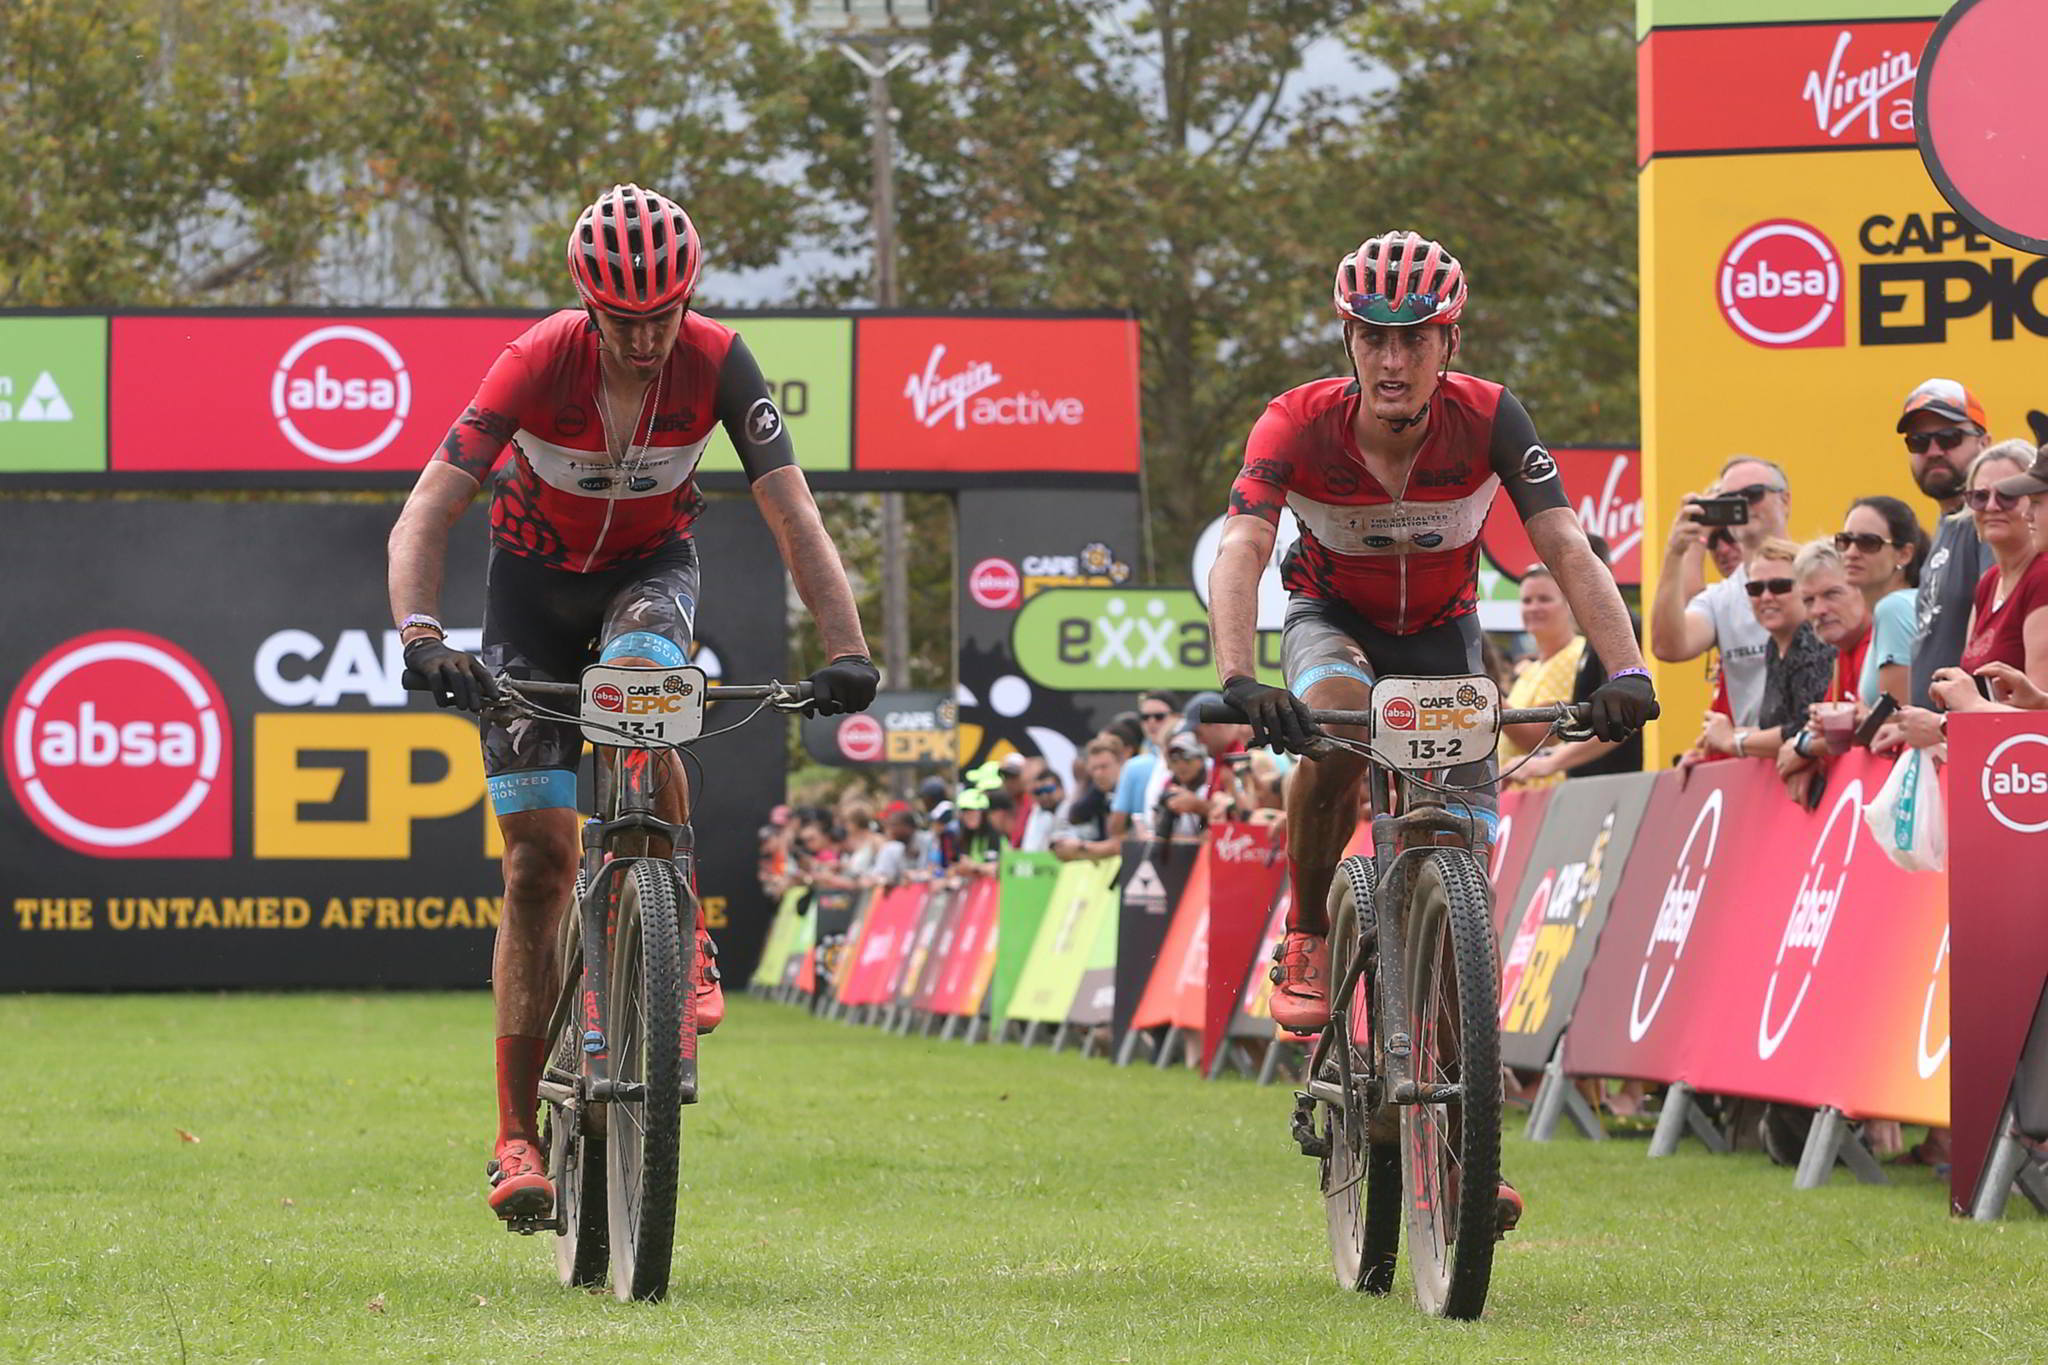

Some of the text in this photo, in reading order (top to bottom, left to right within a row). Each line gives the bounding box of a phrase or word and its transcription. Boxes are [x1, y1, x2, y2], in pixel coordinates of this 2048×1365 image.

[1803, 31, 1918, 139] Virgin
[1736, 261, 1825, 299] absa
[288, 365, 395, 411] absa
[904, 344, 1002, 431] Virgin
[971, 393, 1084, 426] active
[1578, 455, 1643, 563] Vir
[596, 691, 619, 702] absa
[626, 695, 682, 714] EPIC
[627, 686, 661, 696] CAPE
[1420, 697, 1454, 709] CAPE
[1387, 707, 1412, 718] absa
[1419, 708, 1478, 731] EPIC
[39, 702, 197, 767] absa
[1408, 739, 1462, 759] 13-2
[488, 776, 549, 792] CIALIZED
[1993, 763, 2048, 794] abs
[14, 897, 501, 930] THE UNTAMED AFRICAN
[1656, 865, 1696, 942] absa
[1787, 863, 1836, 947] absa
